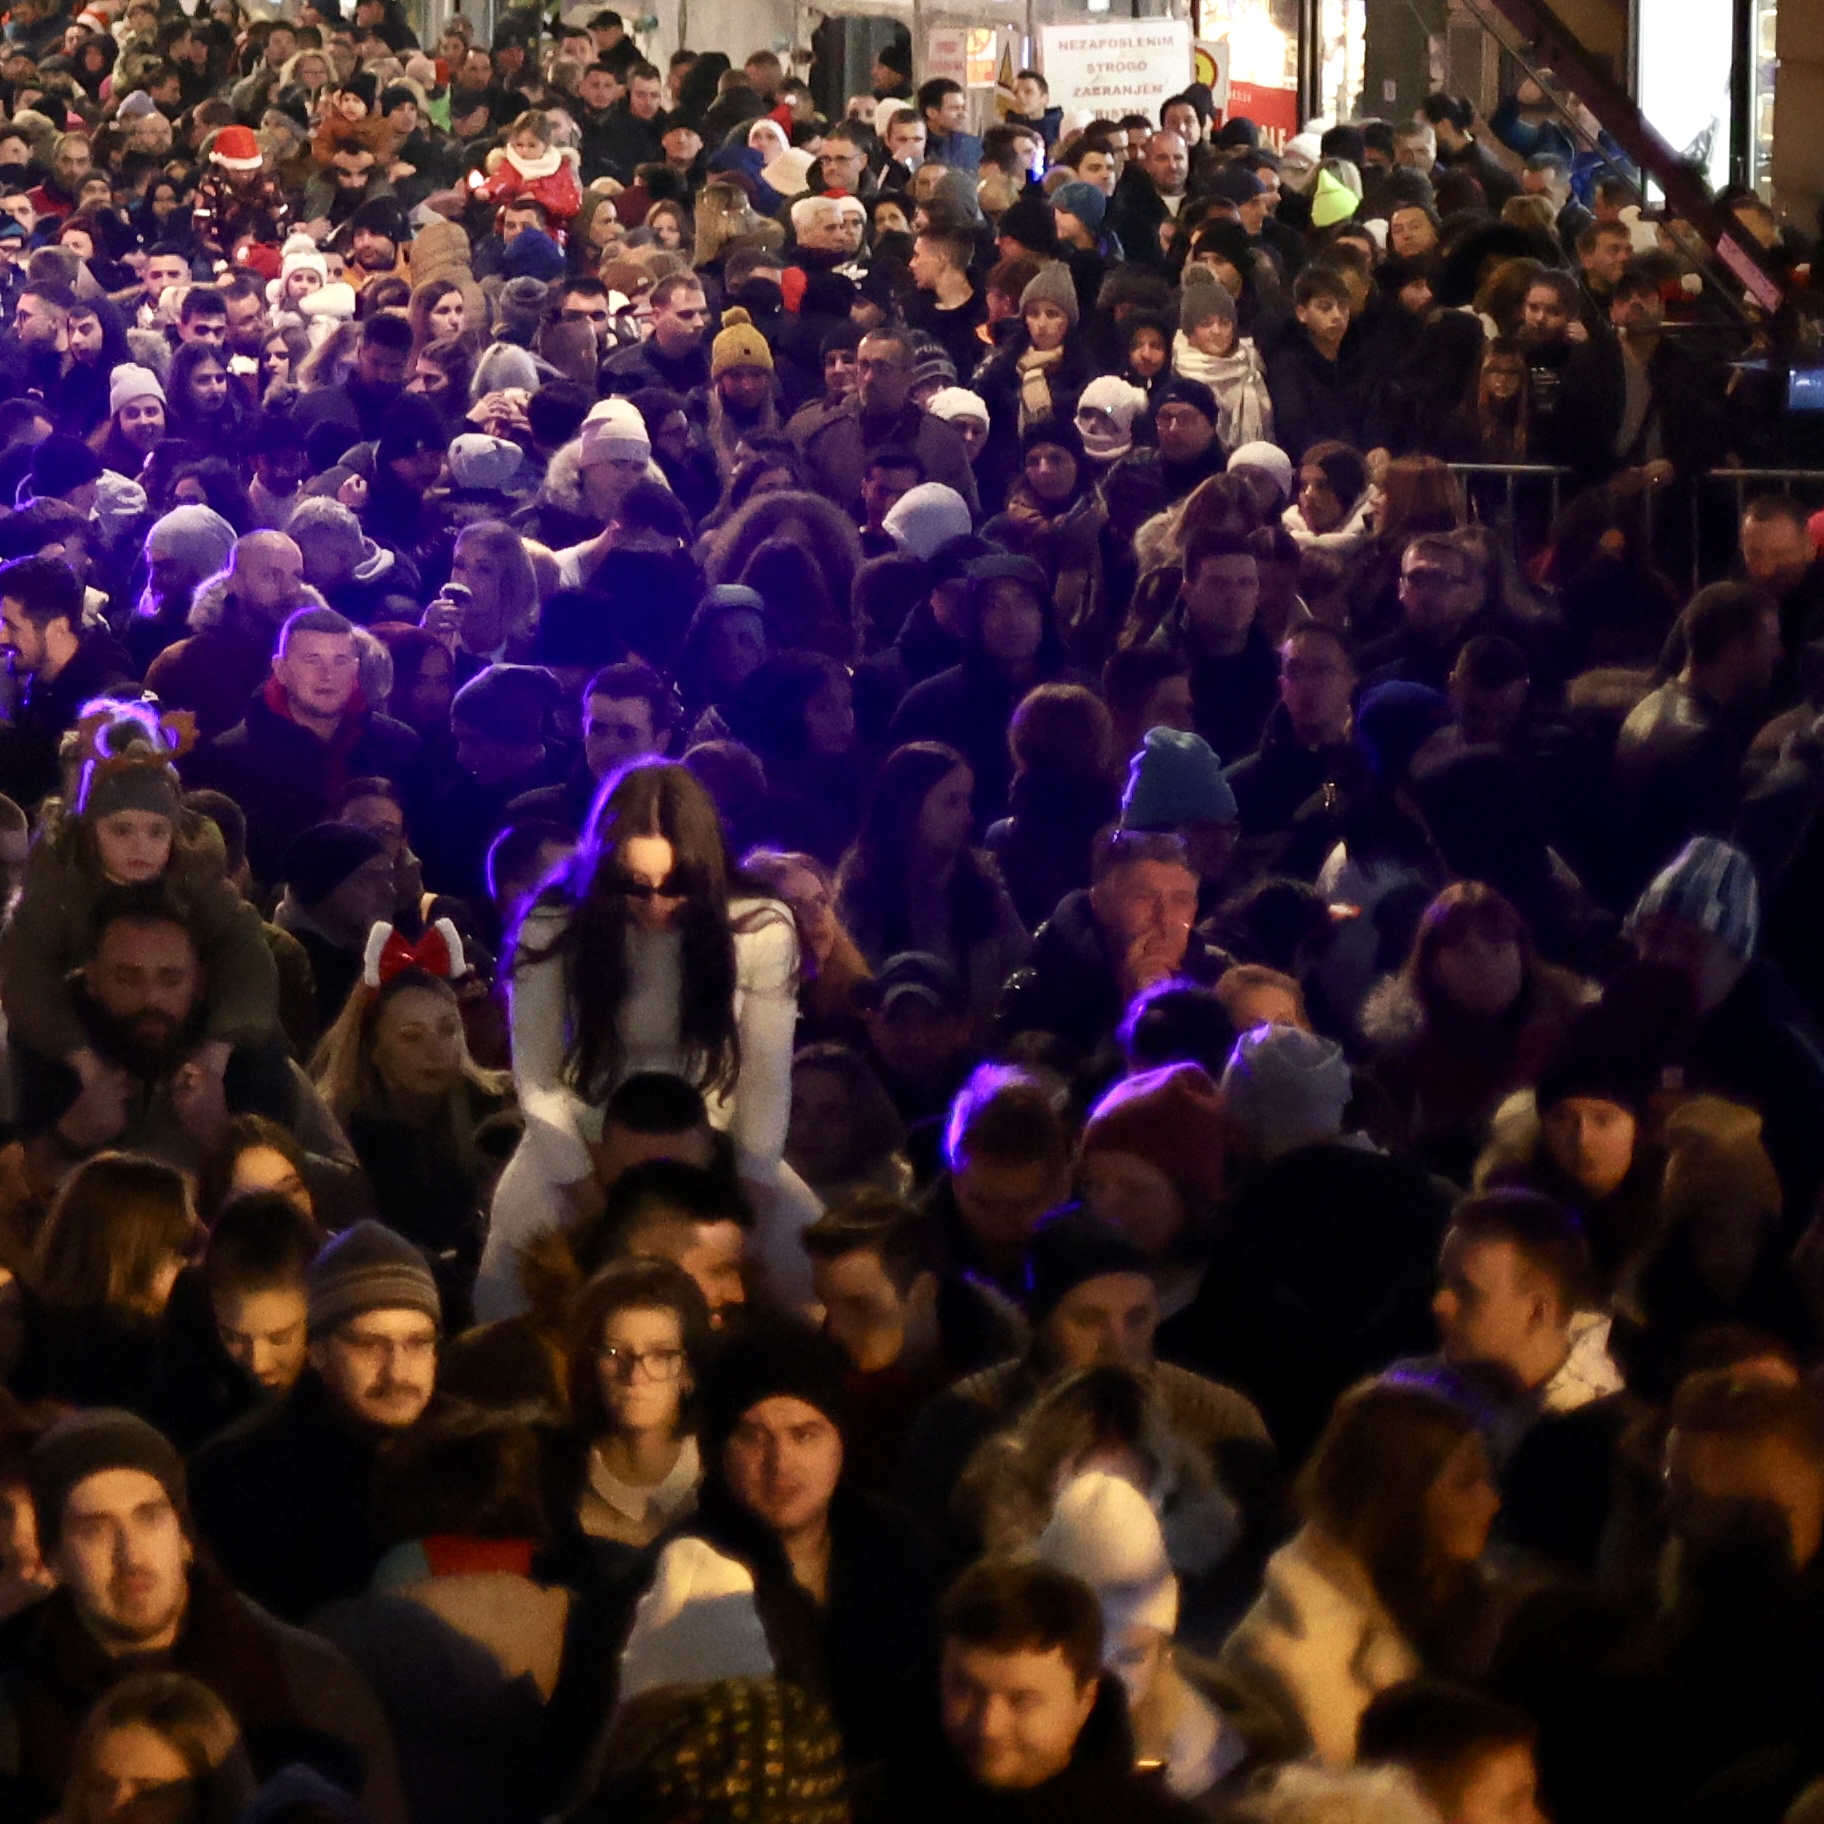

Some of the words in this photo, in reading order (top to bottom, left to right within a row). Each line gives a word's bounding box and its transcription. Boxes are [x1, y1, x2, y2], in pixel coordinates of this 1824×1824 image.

[1058, 35, 1175, 52] NEZAPOSLENIM
[1086, 60, 1148, 74] STROGO
[1072, 84, 1164, 98] ZABRANJEN
[1090, 107, 1150, 121] RISTUP
